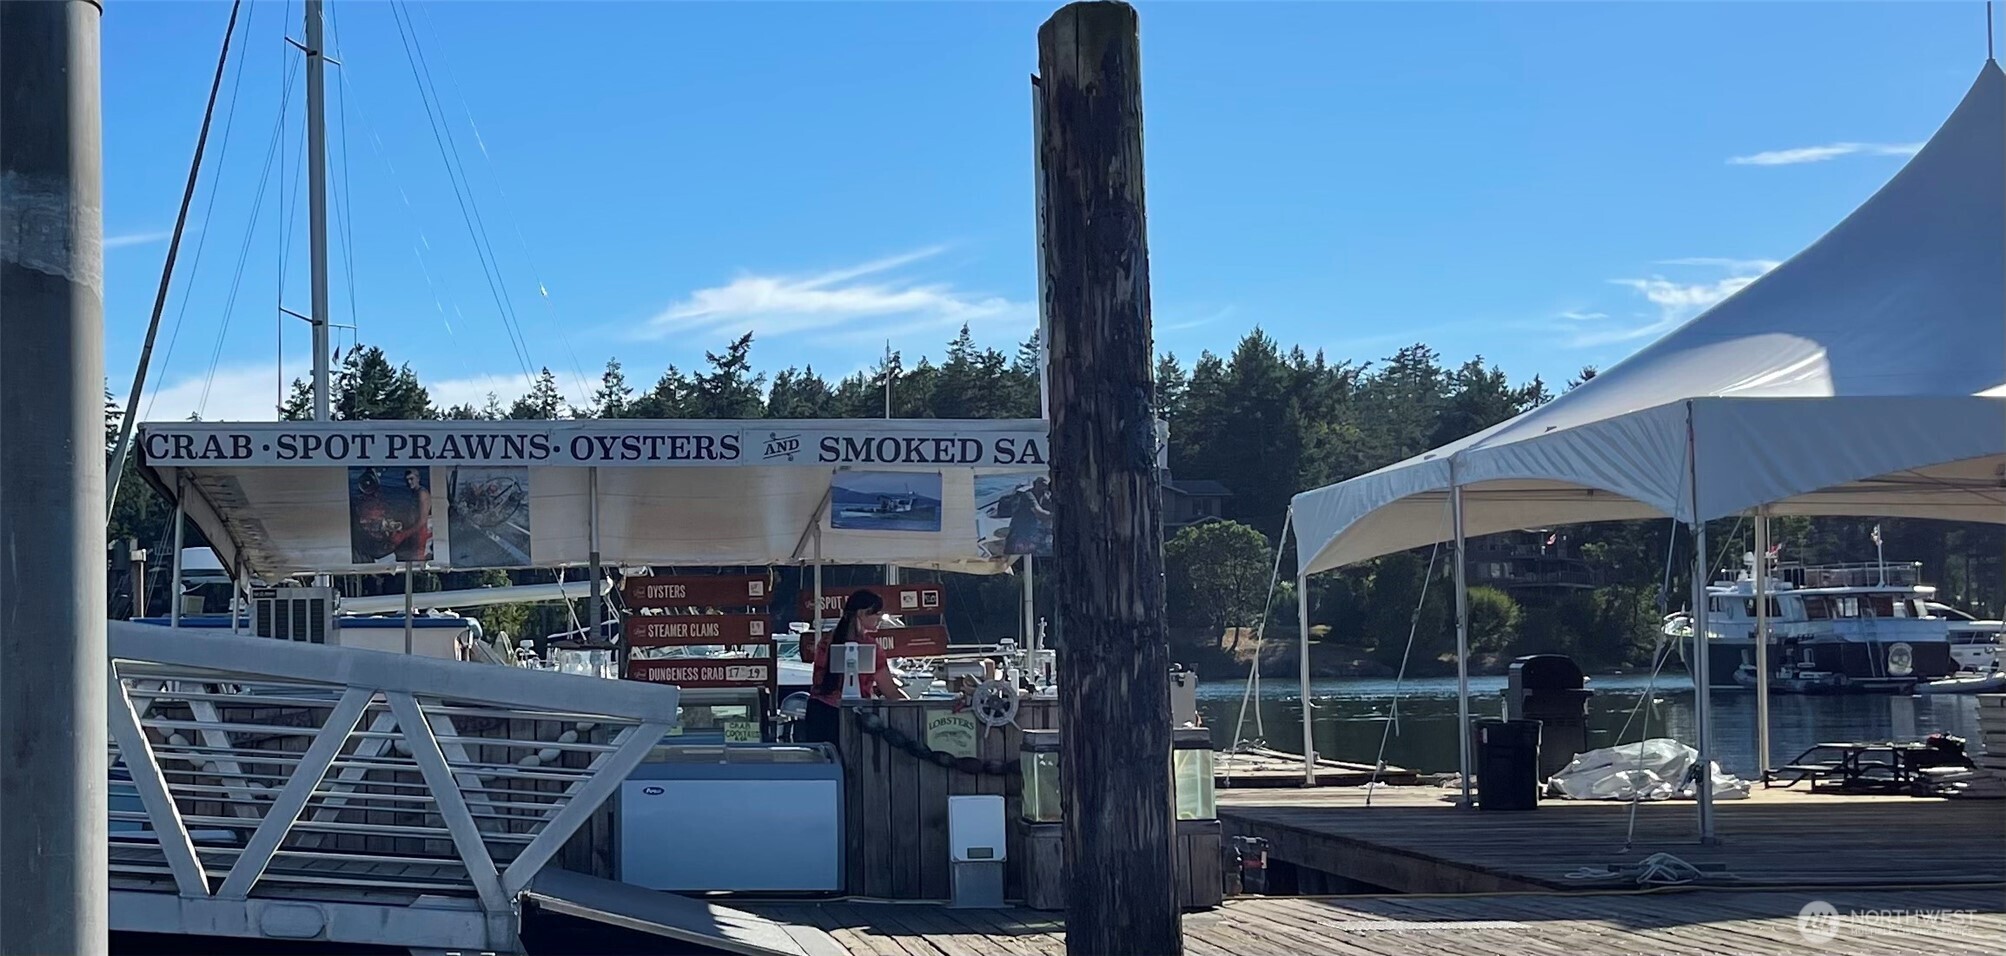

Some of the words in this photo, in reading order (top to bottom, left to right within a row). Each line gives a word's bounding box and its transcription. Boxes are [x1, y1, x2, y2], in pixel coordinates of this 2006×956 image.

[146, 433, 253, 460] CRAB
[276, 433, 376, 460] SPOT
[384, 433, 550, 460] PRAWNS
[569, 434, 740, 461] OYSTERS
[763, 437, 800, 457] AND
[818, 435, 984, 464] SMOKED
[993, 437, 1050, 465] SA
[647, 584, 686, 599] OYSTERS
[820, 596, 843, 610] SPOT
[647, 623, 688, 638] STEAMER
[690, 622, 720, 637] CLAMS
[875, 635, 894, 650] MON
[648, 667, 699, 682] DUNGENESS
[701, 666, 725, 681] CRAB
[928, 716, 975, 731] LOBSTERS
